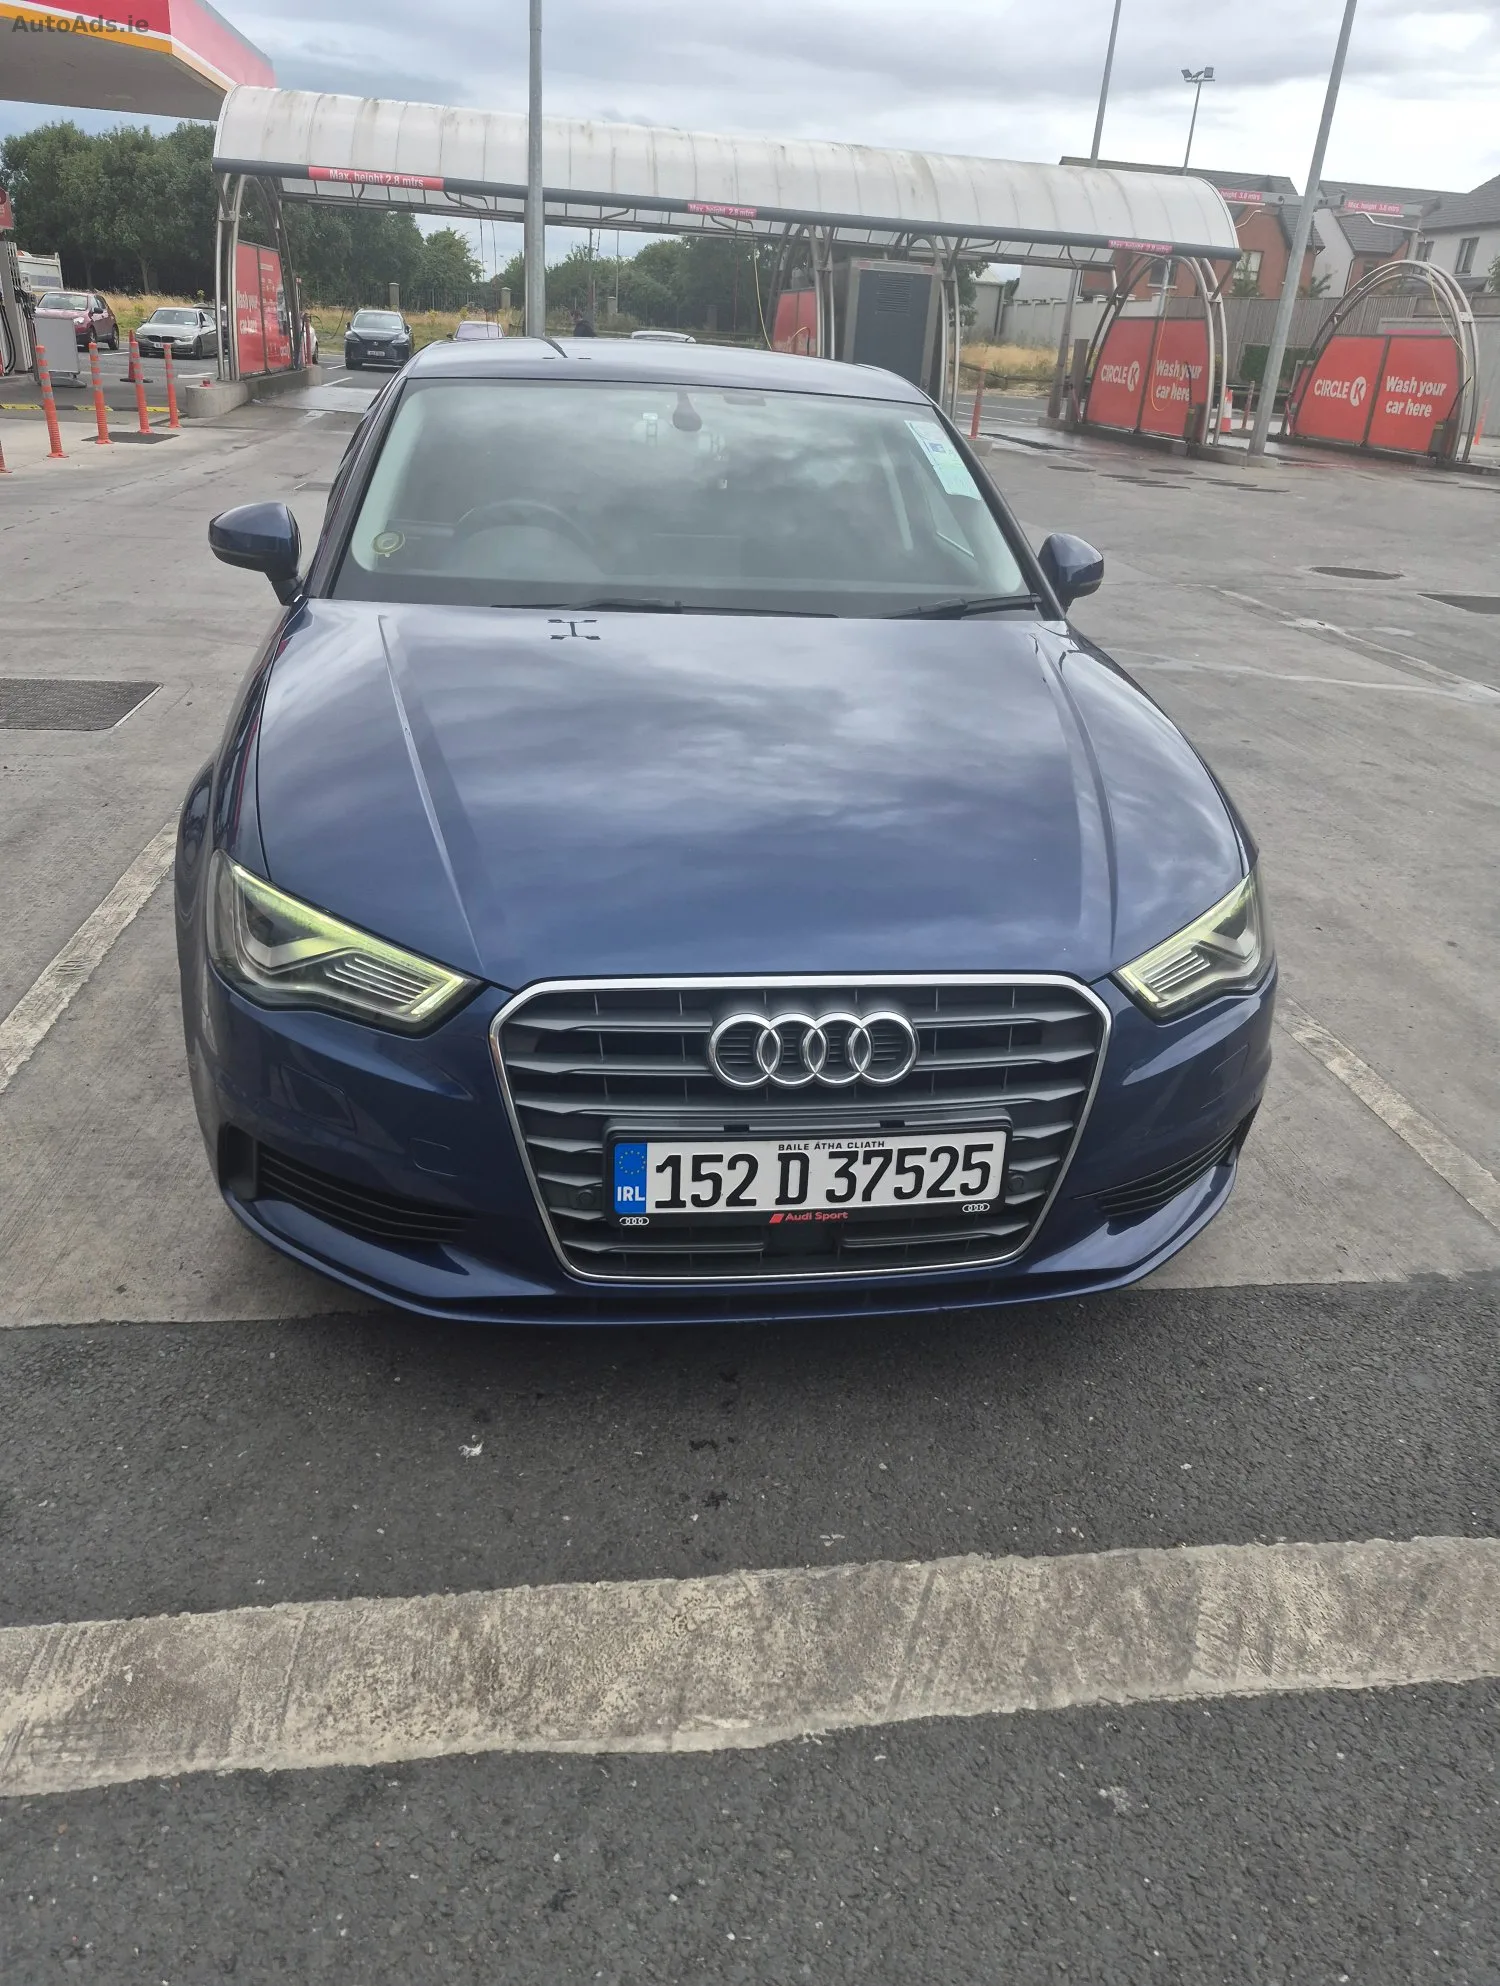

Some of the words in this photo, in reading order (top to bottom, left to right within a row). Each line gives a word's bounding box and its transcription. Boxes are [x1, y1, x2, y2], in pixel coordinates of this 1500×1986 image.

[329, 169, 352, 181] Max.
[354, 171, 384, 186] height
[386, 174, 400, 186] 2.8
[402, 177, 424, 188] mtrs
[1101, 364, 1129, 384] CIRCLE
[1156, 360, 1180, 377] Wash
[1178, 363, 1203, 381] your
[1155, 385, 1170, 399] car
[1170, 383, 1190, 402] here
[1314, 379, 1350, 399] CIRCLE
[1386, 376, 1418, 393] Wash
[1416, 381, 1447, 398] your
[1385, 400, 1405, 414] car
[1405, 399, 1433, 418] here
[778, 1143, 810, 1151] BAILE
[813, 1141, 842, 1150] ÁTHA
[847, 1140, 885, 1149] CLIATH
[655, 1153, 759, 1209] 152
[775, 1151, 810, 1206] D
[825, 1143, 994, 1204] 37525
[616, 1186, 645, 1202] IRL
[785, 1211, 813, 1221] Audi
[815, 1211, 849, 1222] Sport
